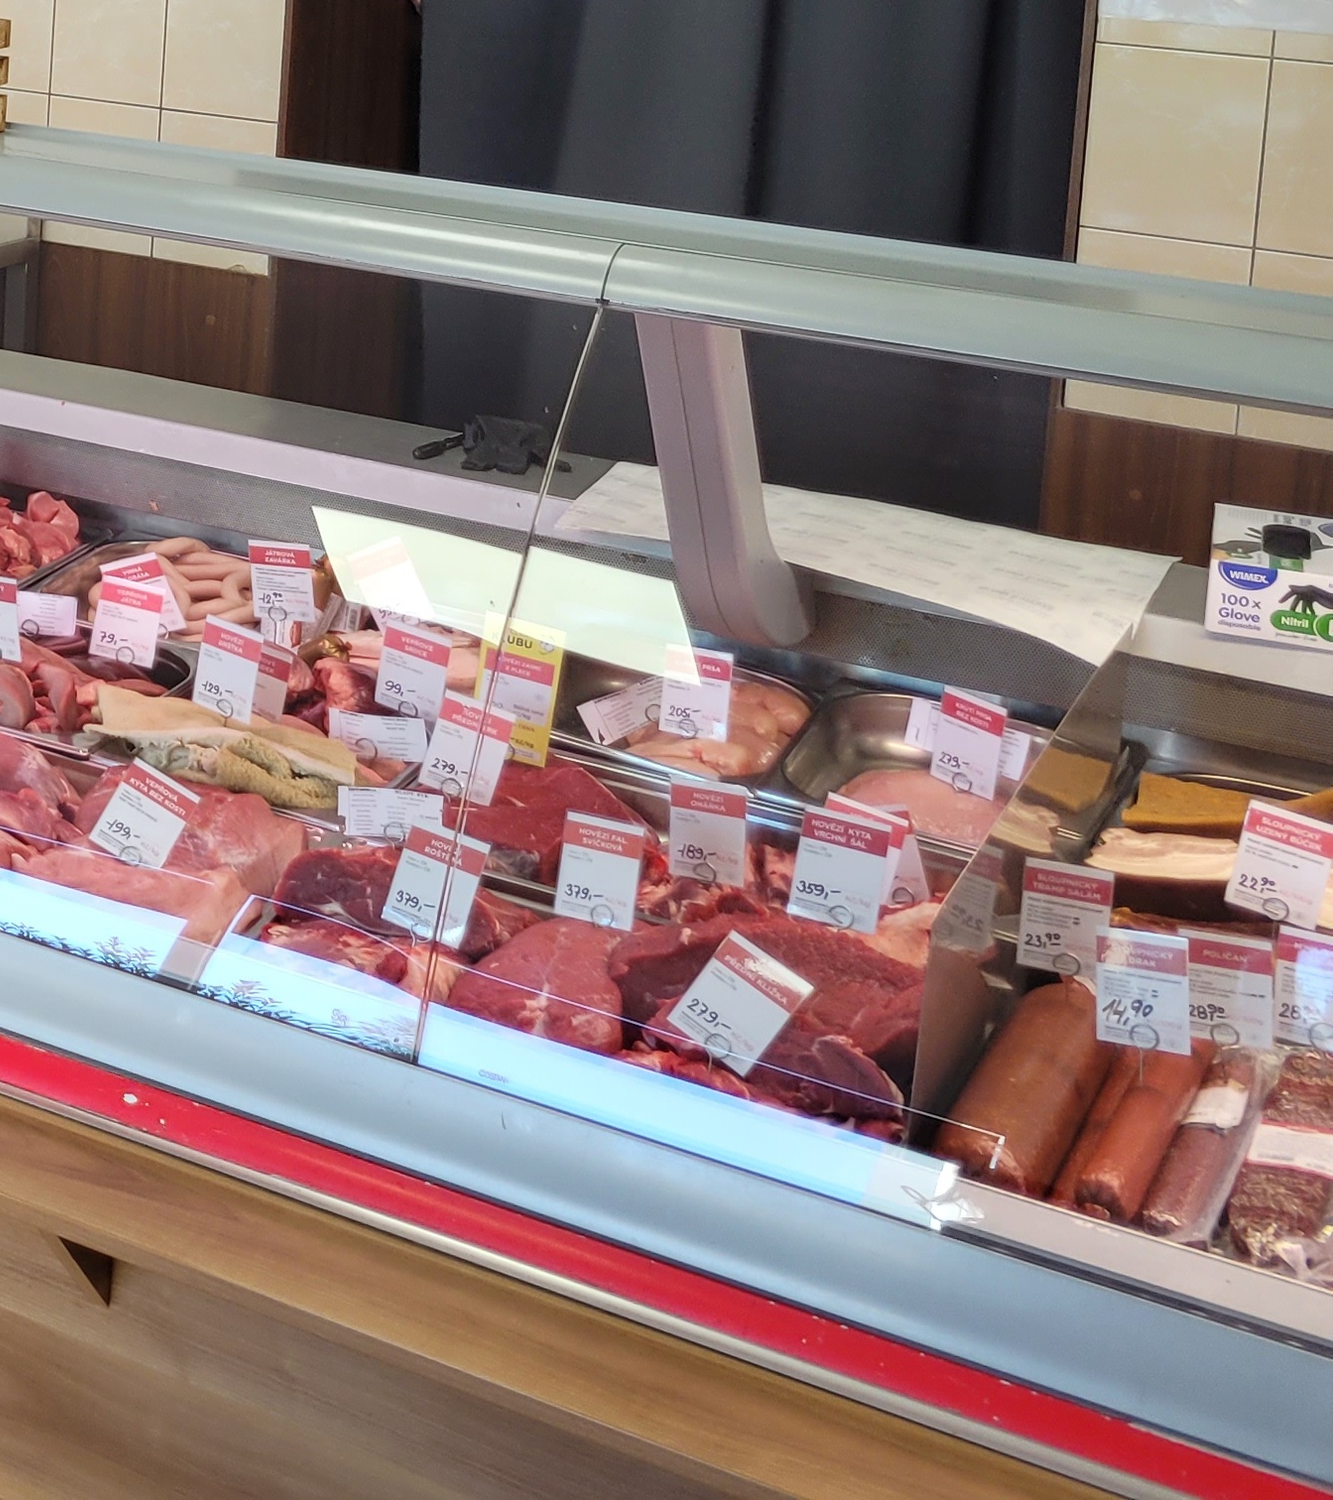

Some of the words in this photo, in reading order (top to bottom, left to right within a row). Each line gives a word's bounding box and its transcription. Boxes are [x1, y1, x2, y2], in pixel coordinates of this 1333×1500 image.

[263, 556, 297, 566] ZAVÁŘKA
[264, 549, 296, 559] JÁTROVÁ
[1229, 569, 1269, 584] WIMEX
[1221, 592, 1249, 608] 100
[1252, 600, 1262, 610] x
[1218, 606, 1261, 623] Glove
[1280, 615, 1309, 629] Nitril
[100, 630, 129, 646] 79,-
[400, 635, 435, 653] VEPŘOVÉ
[403, 644, 429, 657] SRDCE
[701, 662, 722, 673] PRSA
[384, 679, 416, 697] 99,-
[431, 757, 469, 776] 279,-
[129, 777, 150, 794] KÝTA
[148, 788, 164, 803] BEZ
[163, 798, 187, 817] KOSTI
[144, 776, 180, 803] VEPŘOVÁ
[692, 792, 725, 803] HOVĚZÍ
[105, 819, 141, 841] 199,-
[579, 827, 611, 841] HOVĚZÍ
[812, 818, 846, 835] HOVĚZÍ
[848, 827, 873, 842] KÝTA
[1261, 815, 1323, 842] SLOUPNICKÝ
[582, 836, 624, 852] SVÍČKOVÁ
[813, 828, 847, 844] VRCHNÍ
[849, 836, 868, 850] ŠÁL
[1255, 824, 1289, 842] UZENÝ
[1289, 833, 1323, 852] BŮČEK
[796, 880, 841, 900] 359,-
[1033, 881, 1065, 894] TRAMP
[1066, 886, 1102, 901] SALÁM
[1036, 872, 1099, 892] SLOUPNICKÝ
[395, 889, 436, 911] 379,-
[564, 882, 604, 901] 379,-
[1202, 948, 1249, 964] POLIČAN
[724, 954, 755, 981] PŘEDNÍ
[755, 979, 787, 1005] KLIŽKA
[686, 998, 732, 1030] 279,-
